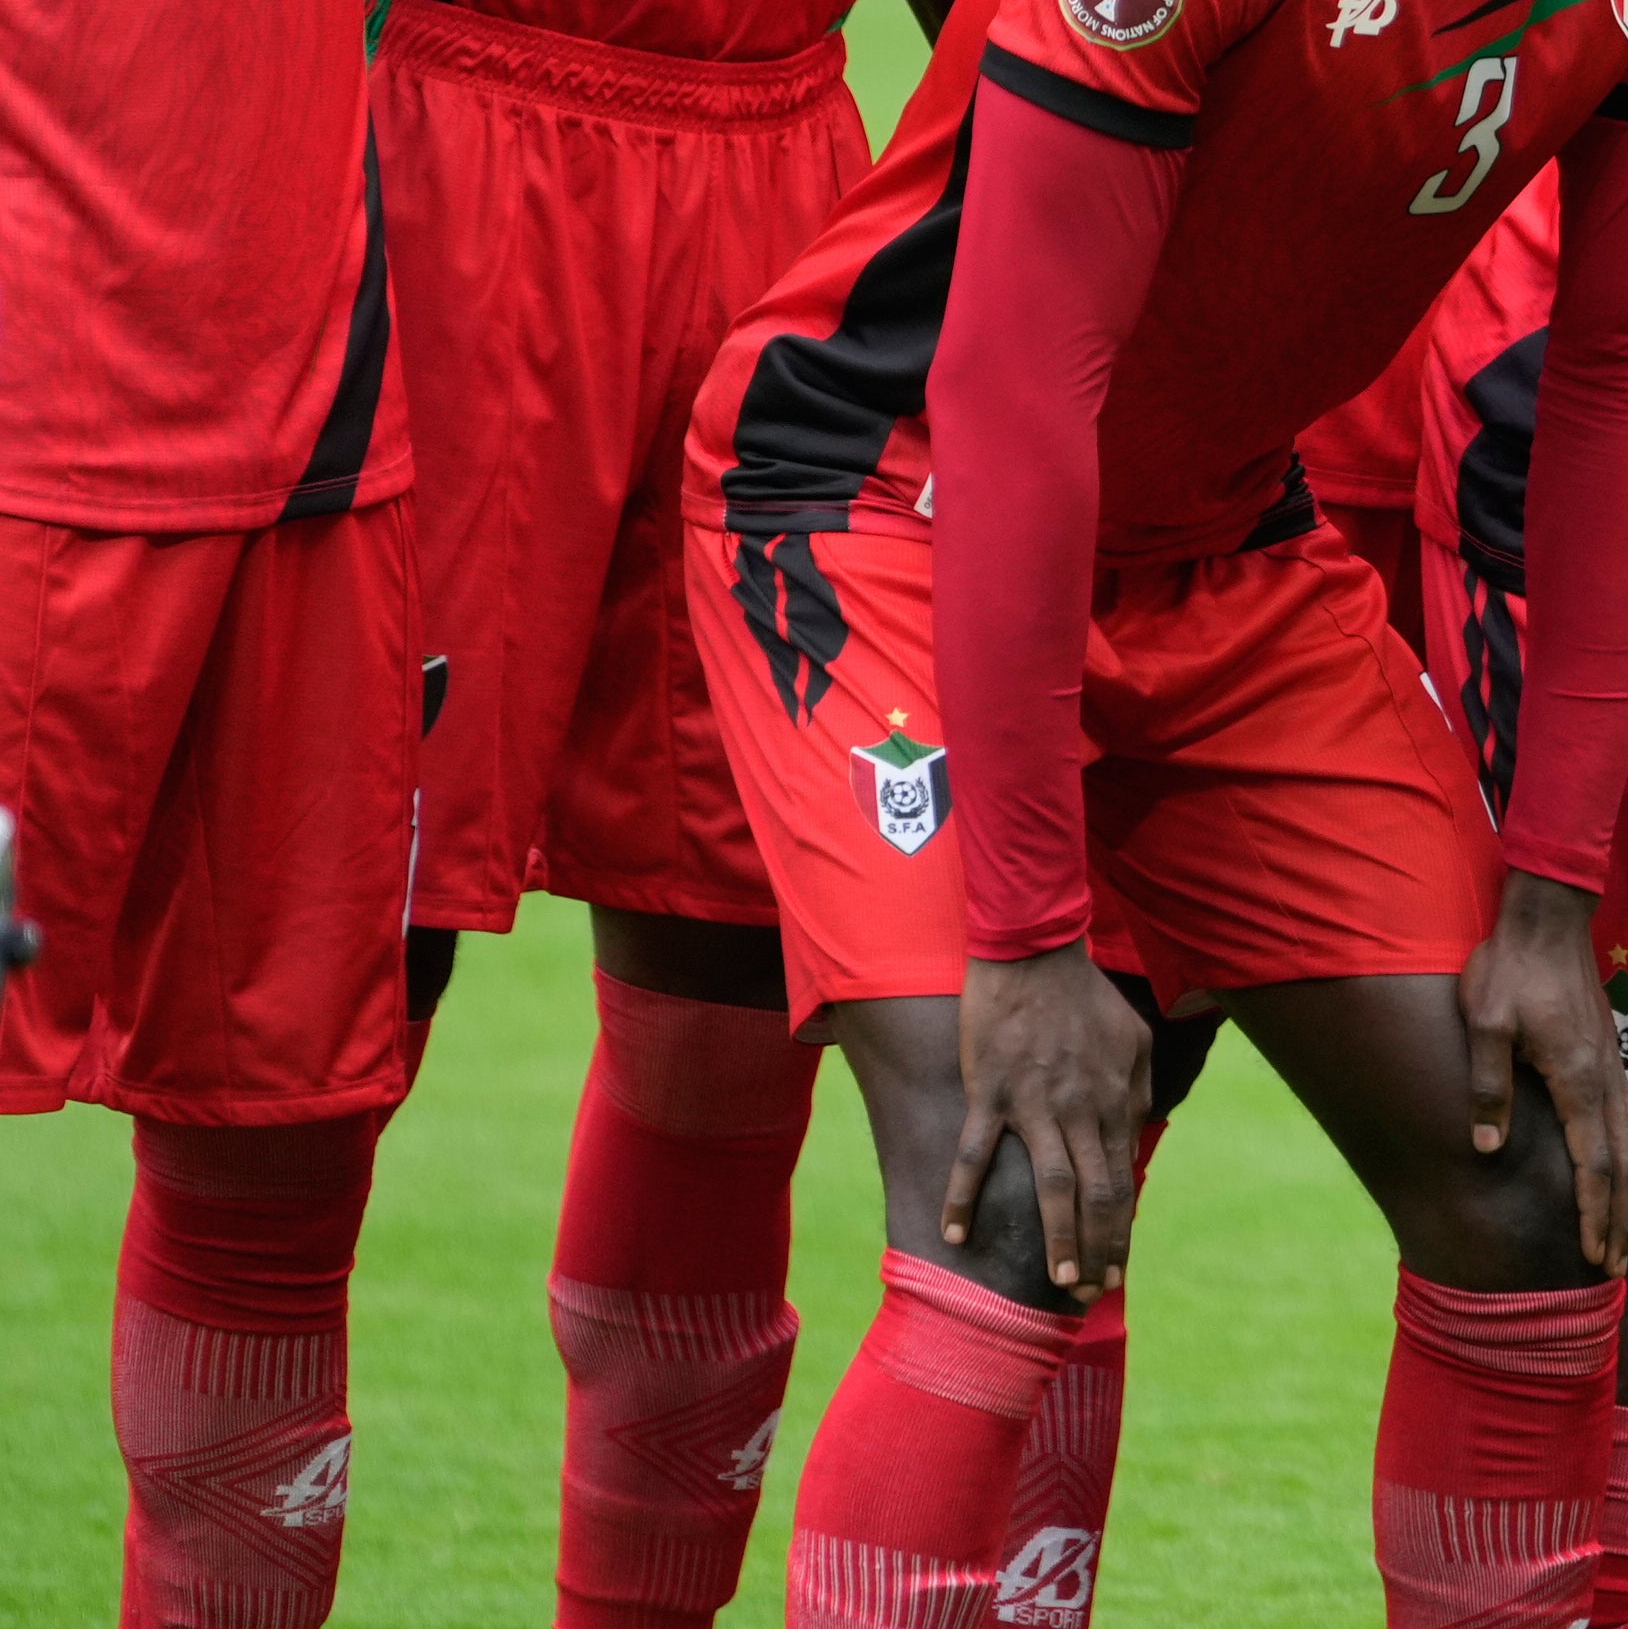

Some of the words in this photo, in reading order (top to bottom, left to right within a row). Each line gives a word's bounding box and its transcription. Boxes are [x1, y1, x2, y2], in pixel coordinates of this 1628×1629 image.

[1152, 7, 1167, 25] OF
[1100, 24, 1155, 41] NATIONS
[1409, 56, 1517, 215] 3
[887, 822, 926, 834] S.F.A
